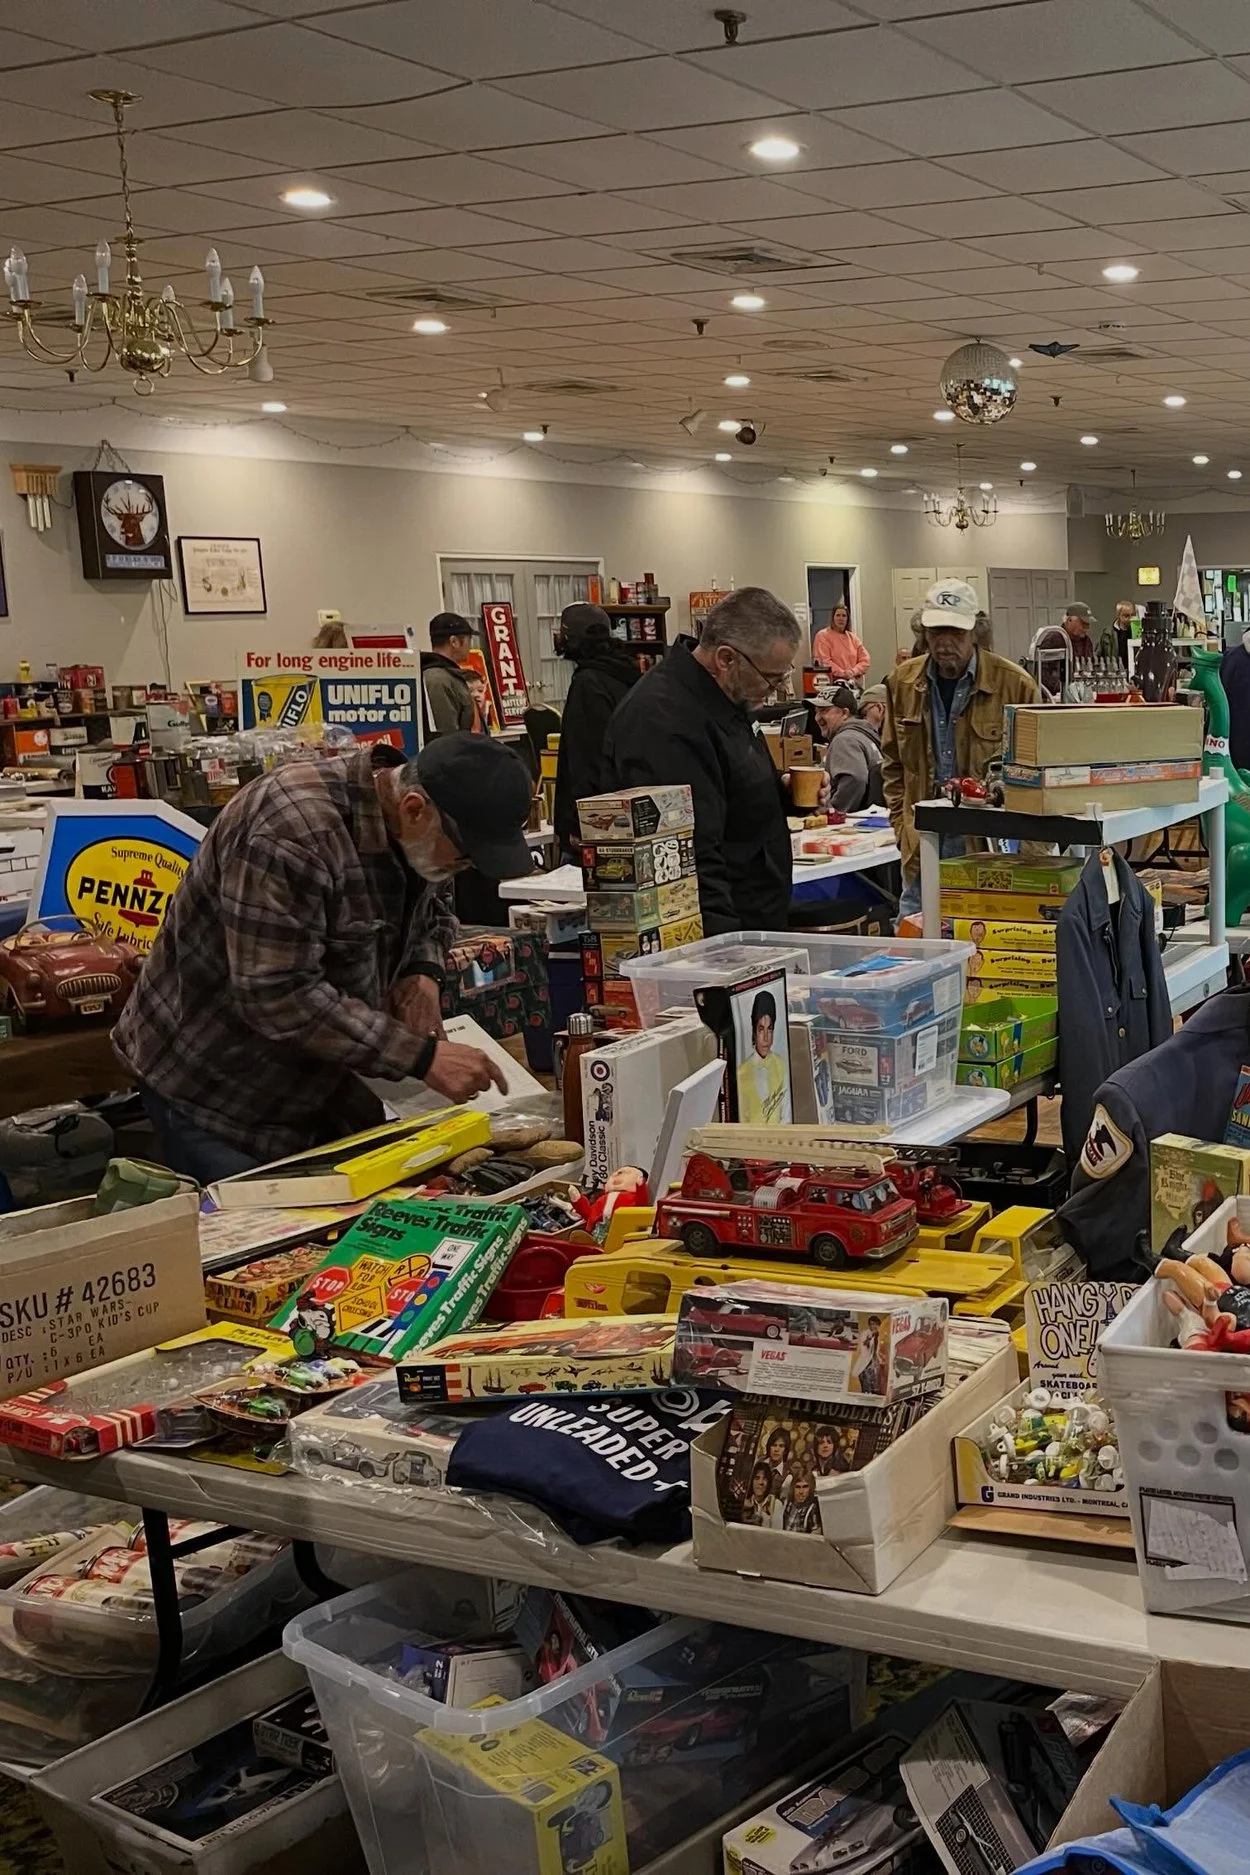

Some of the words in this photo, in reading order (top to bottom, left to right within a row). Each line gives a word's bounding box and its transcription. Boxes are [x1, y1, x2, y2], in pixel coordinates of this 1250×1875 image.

[246, 652, 272, 668] For
[277, 652, 313, 671] long
[318, 652, 378, 672] engine
[490, 607, 519, 697] GRANT
[328, 684, 411, 706] UNIFLO
[328, 708, 387, 722] motor
[389, 707, 412, 722] oil
[1206, 737, 1226, 749] INO
[111, 847, 153, 863] Supreme
[77, 876, 173, 915] PENNZ
[93, 911, 114, 938] Safe
[115, 926, 154, 950] Lubric
[842, 1046, 867, 1056] FORD
[588, 1120, 597, 1168] Davidson
[598, 1126, 606, 1161] Classic
[355, 1217, 407, 1241] Signs
[368, 1202, 434, 1229] Reeves
[432, 1214, 489, 1240] Traffic
[359, 1260, 390, 1275] WATCH
[478, 1256, 510, 1297] Traffic
[505, 1216, 529, 1257] Signs
[312, 1277, 345, 1292] STOP
[357, 1273, 376, 1284] FOR
[440, 1270, 479, 1315] Traffic
[474, 1235, 505, 1271] Signs
[0, 1292, 48, 1328] SKU
[55, 1286, 74, 1315] #
[82, 1263, 156, 1305] 42683
[390, 1288, 416, 1302] STO
[1032, 1282, 1099, 1325] HANG
[99, 1311, 131, 1329] KID'S
[138, 1302, 160, 1317] CUP
[2, 1326, 32, 1344] DESC
[1040, 1319, 1099, 1361] ONE!
[6, 1353, 35, 1370] QTY.
[89, 1331, 104, 1346] EA
[7, 1365, 33, 1384] P/U
[91, 1345, 105, 1360] EA
[1033, 1361, 1059, 1369] Around
[1040, 1380, 1098, 1389] SKATEBOAR
[509, 1401, 659, 1482] UNLEADED
[588, 1402, 690, 1460] SUPER
[997, 1491, 1019, 1499] GRAND
[1021, 1494, 1060, 1503] INDUSTRIES
